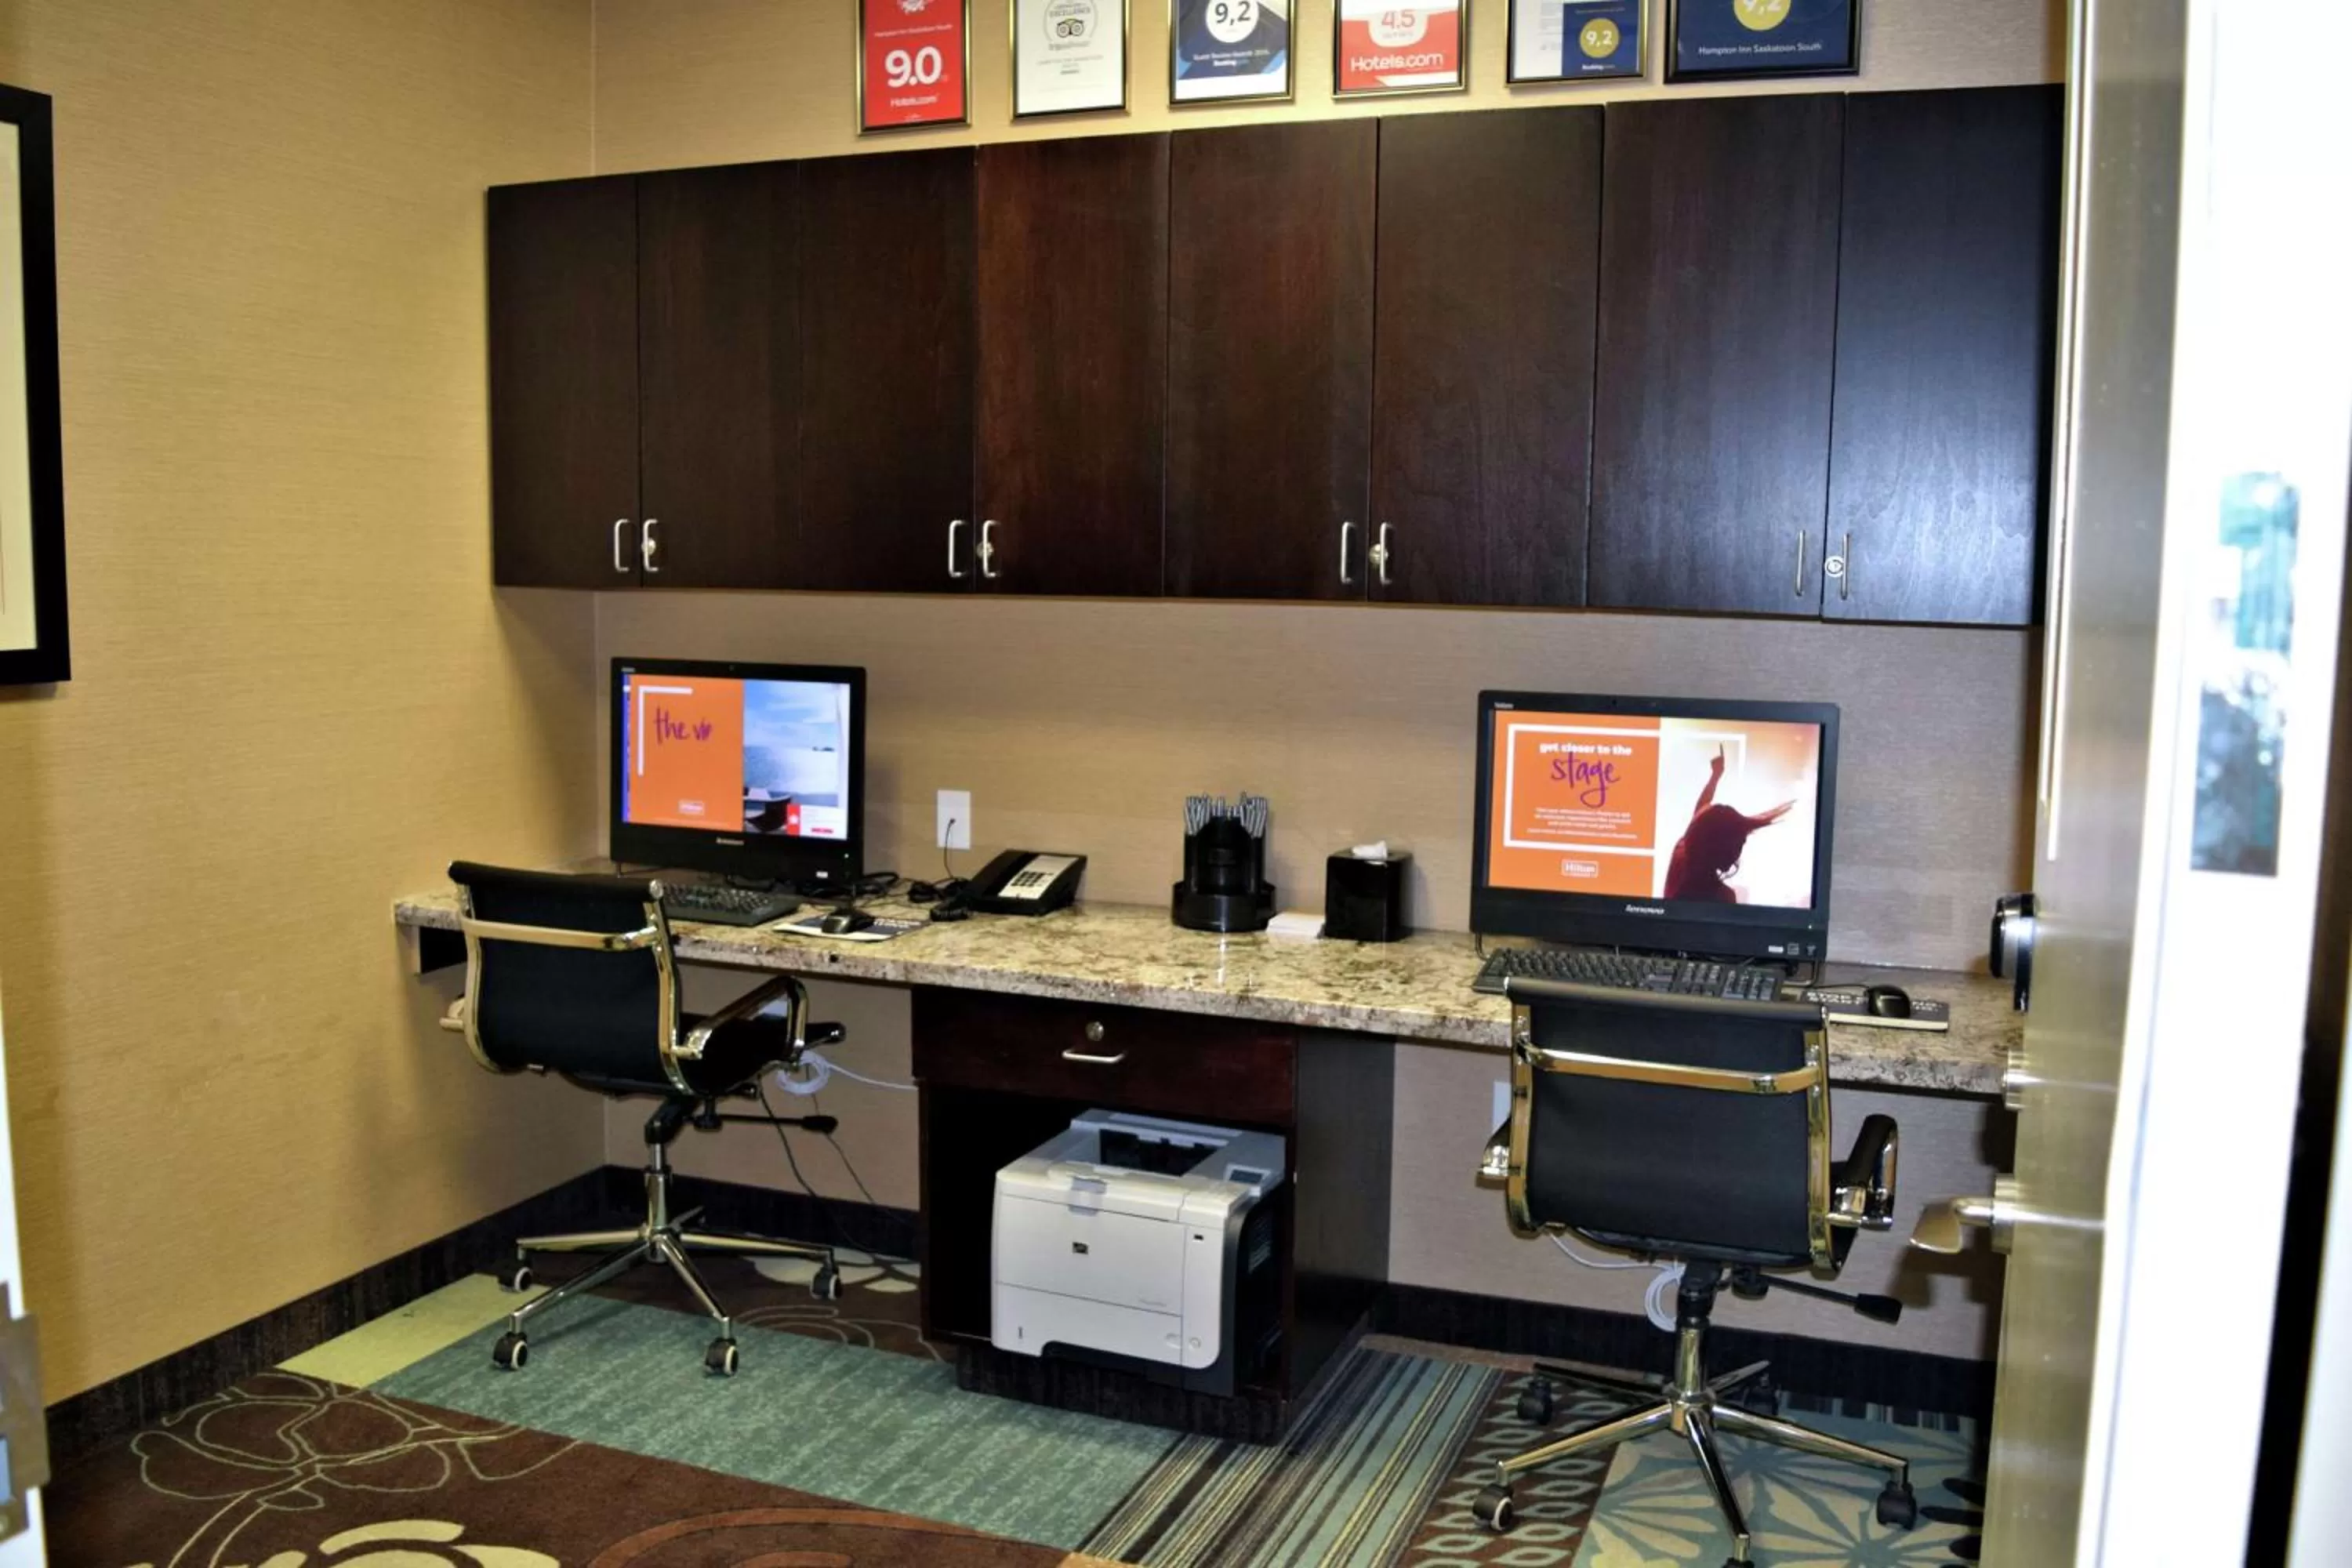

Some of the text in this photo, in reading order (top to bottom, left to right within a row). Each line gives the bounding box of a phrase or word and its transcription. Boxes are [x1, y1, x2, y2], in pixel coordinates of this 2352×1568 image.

[1214, 1, 1251, 26] 9,2
[1585, 30, 1613, 47] 9,2
[1698, 42, 1822, 56] Hampton Inn Saskatoon South
[884, 45, 942, 89] 9.0
[1351, 53, 1443, 72] Hotels.com
[653, 706, 691, 746] the
[1540, 742, 1632, 757] get closer to the
[1551, 752, 1621, 809] stage
